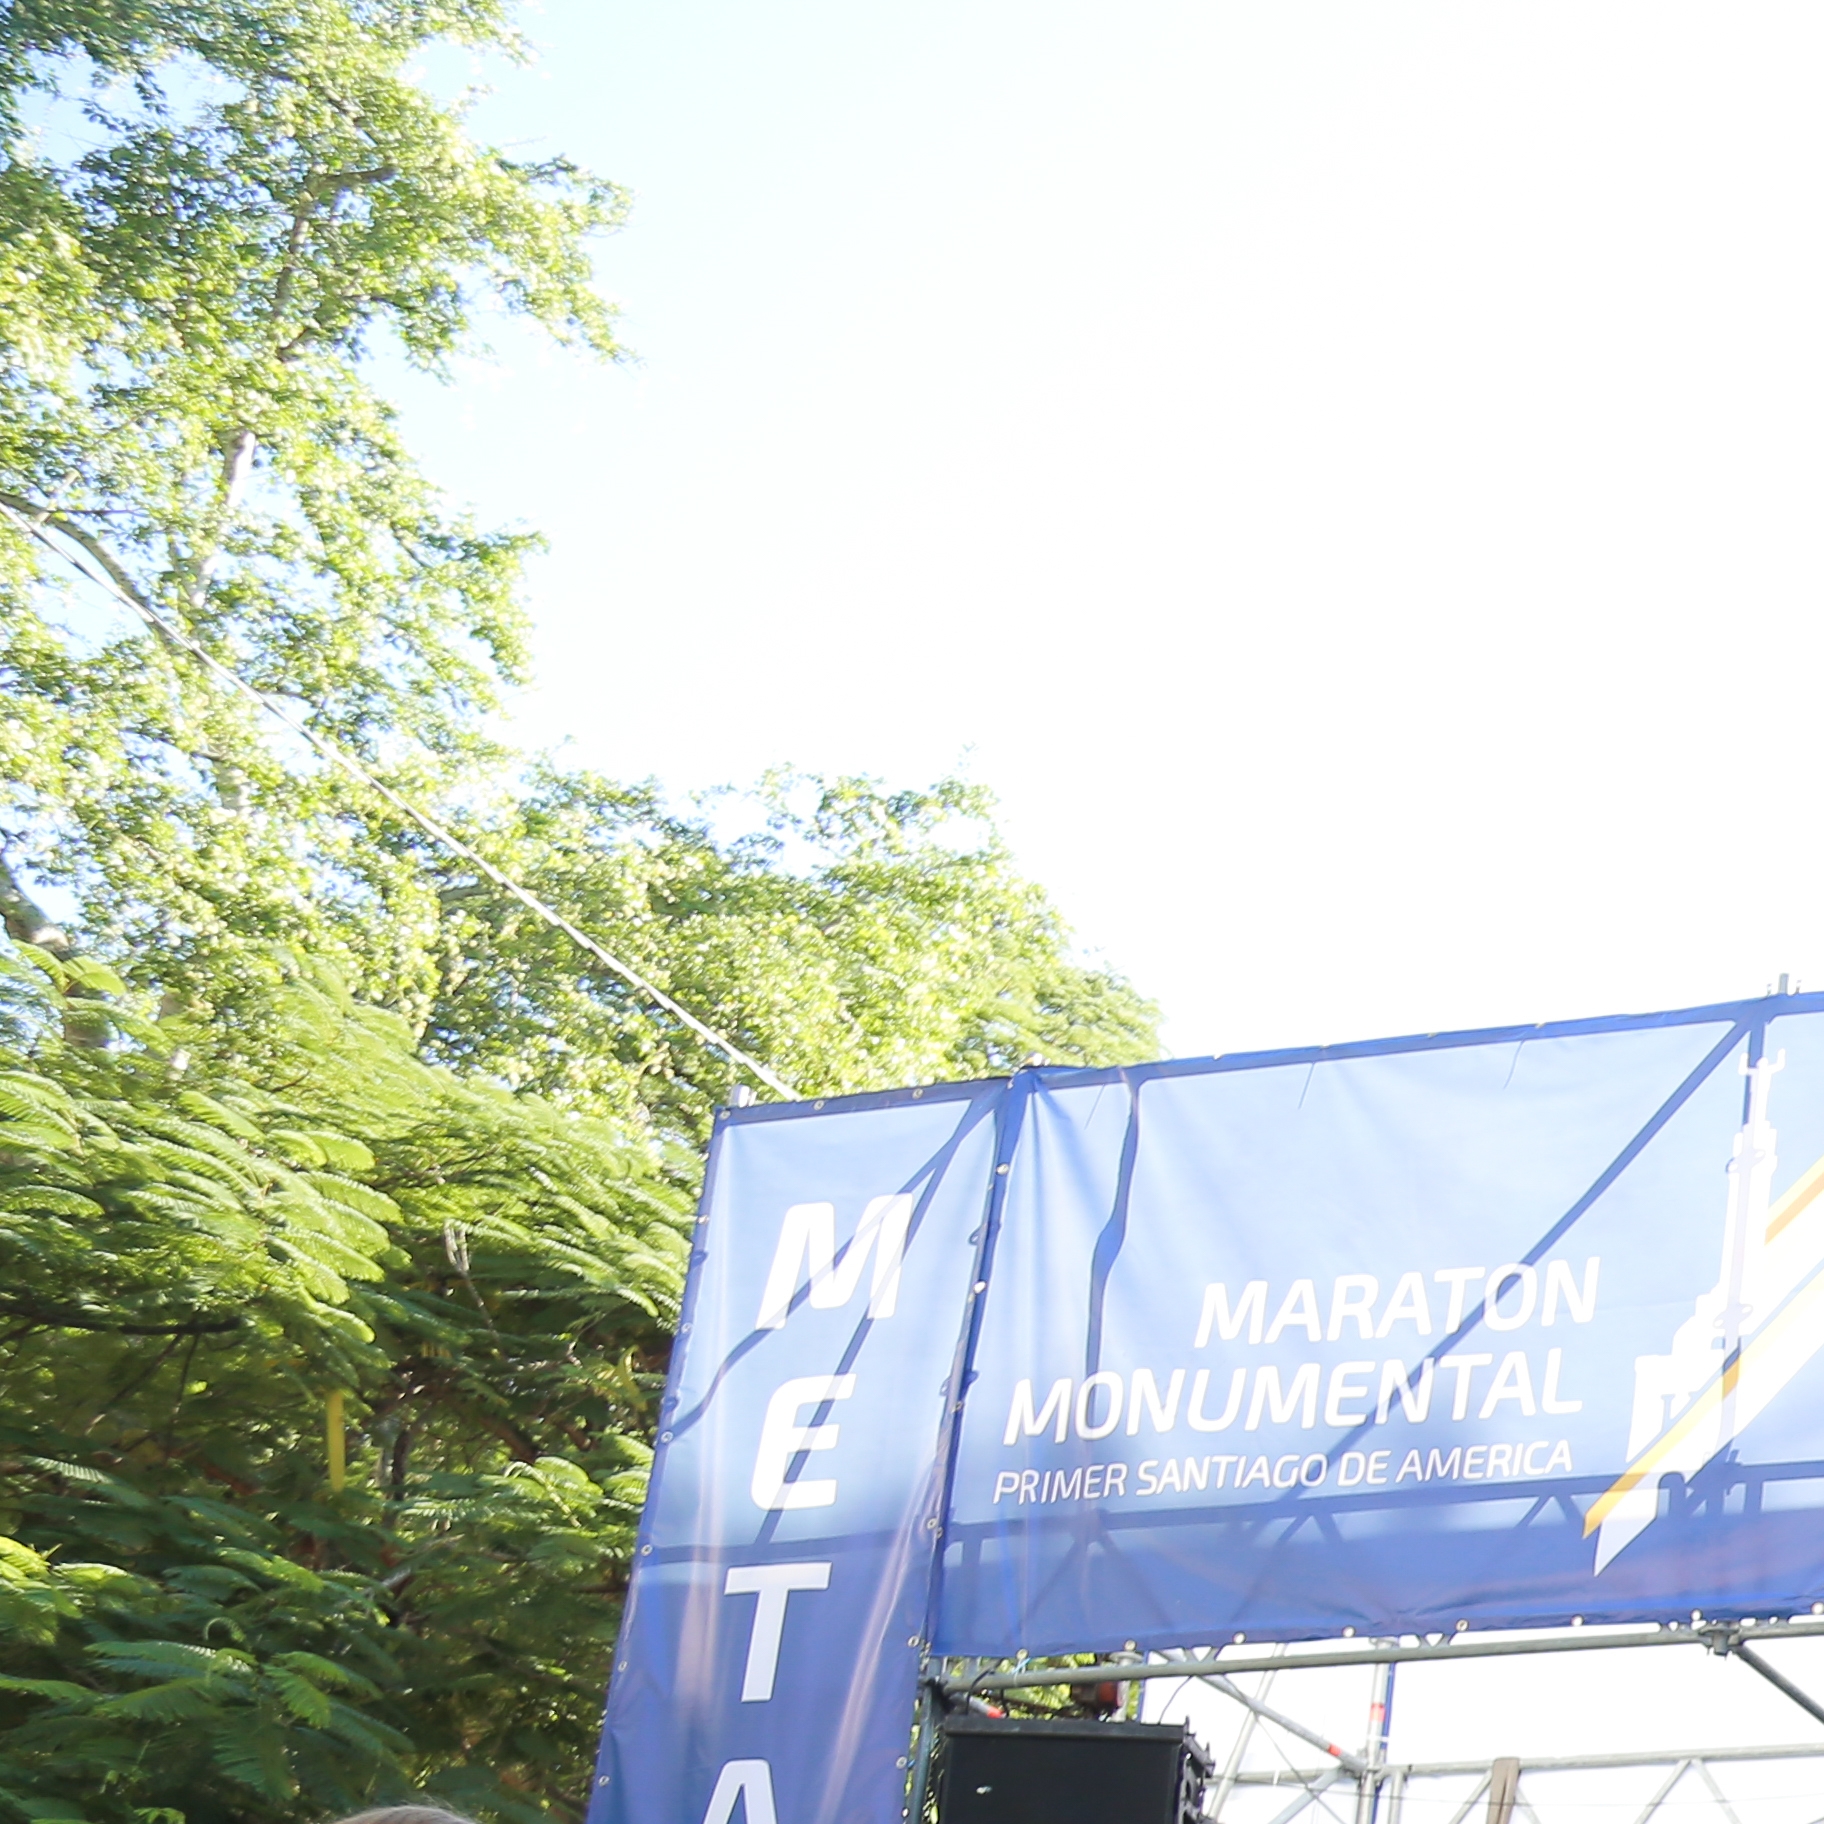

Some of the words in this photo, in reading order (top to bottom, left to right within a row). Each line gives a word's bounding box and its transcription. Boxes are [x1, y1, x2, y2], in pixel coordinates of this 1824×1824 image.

[1195, 1256, 1600, 1348] MARATON
[1004, 1348, 1585, 1445] MONUMENTAL
[993, 1462, 1126, 1505] PRIMER
[1136, 1451, 1328, 1497] SANTIAGO
[1338, 1450, 1387, 1488] DE
[1395, 1440, 1573, 1483] AMERICA
